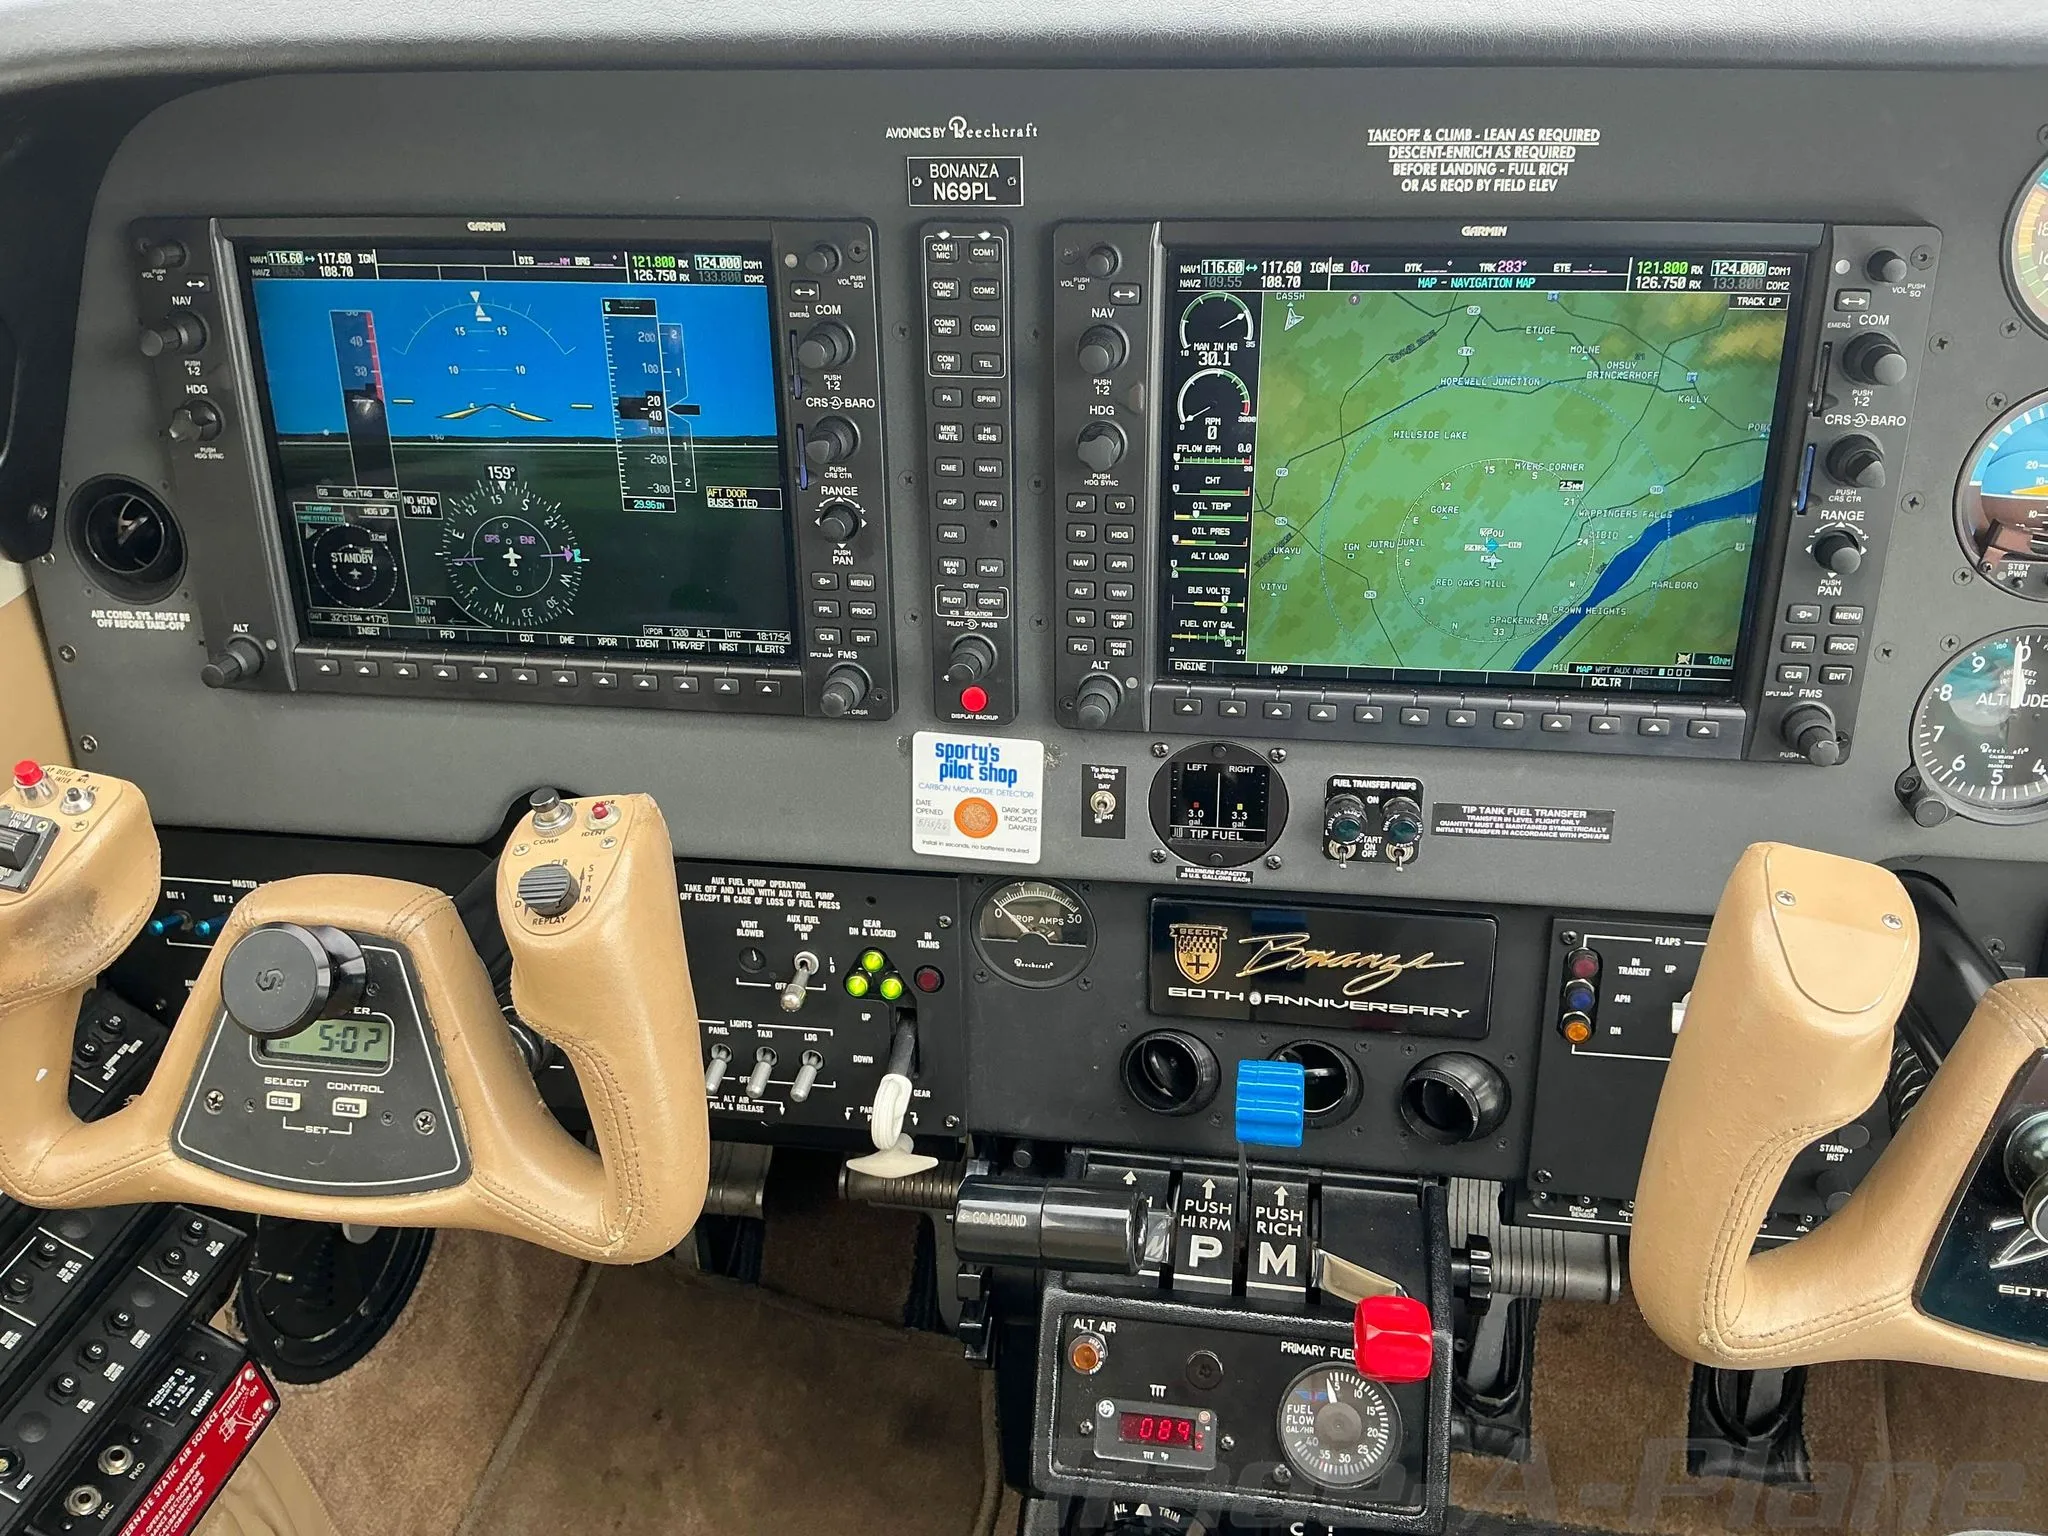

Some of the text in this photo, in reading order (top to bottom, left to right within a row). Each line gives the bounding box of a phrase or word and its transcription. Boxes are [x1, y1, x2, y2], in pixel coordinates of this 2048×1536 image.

[885, 116, 1038, 139] AVIONICS BY Beechcraft
[1368, 128, 1600, 142] TAKEOFF & CLIMB LEAN AS REQUIRED
[1389, 146, 1576, 159] DESCENT-ENRICH AS REQUIRED
[929, 163, 999, 178] BONANZA
[1393, 163, 1568, 176] BEFORE LANDING FULL RICH
[1402, 179, 1558, 192] OR AS REQD BY FIELD ELEV
[933, 182, 997, 201] N69PL
[467, 221, 506, 231] GARMIN
[1461, 226, 1507, 237] GARMIN
[269, 253, 351, 264] 116.60 117.60
[632, 255, 741, 269] 121.800 124.000
[319, 266, 353, 277] 108.70
[1203, 261, 1328, 274] 116.60 117.60 IGN
[1637, 262, 1765, 276] 121.800 124.000
[633, 269, 676, 281] 126.750
[1261, 276, 1301, 288] 108.70
[1418, 277, 1535, 288] MAP NAVIGATION MAP
[1635, 277, 1686, 290] 126.750
[172, 296, 192, 306] NAV
[1737, 296, 1781, 307] TRACK UP
[815, 304, 841, 315] COM
[1091, 308, 1115, 319] NAV
[1859, 314, 1889, 326] COM
[1198, 352, 1231, 366] 30.1
[1440, 377, 1540, 386] HOPEWELL JUNCTION
[186, 385, 208, 395] HDG
[1089, 405, 1115, 416] HDG
[1393, 431, 1467, 440] HILLSIDE LAKE
[821, 486, 858, 496] RANGE
[1192, 502, 1231, 511] OIL TEMP
[1820, 510, 1865, 521] RANGE
[1191, 527, 1230, 536] OIL PRES
[330, 552, 373, 564] STANDBY
[1191, 553, 1229, 561] ALT LOAD
[1187, 586, 1231, 595] BUS VOLTS
[1651, 580, 1699, 590] MARLBORO
[1817, 586, 1842, 597] PAN
[1835, 611, 1860, 620] MENU
[1180, 620, 1235, 630] FUEL QTY GAL
[755, 644, 785, 655] ALERTS
[1830, 642, 1855, 651] PROC
[1174, 662, 1207, 672] ENGINE
[1591, 677, 1622, 688] DCLTR
[1798, 688, 1823, 698] FMS
[951, 713, 974, 721] DISPLAY
[1933, 725, 1945, 743] 7
[935, 742, 1000, 765] sporty's
[1187, 764, 1254, 773] LEFT RIGHT
[1952, 755, 1965, 772] 6
[939, 760, 1018, 787] pilot shop
[918, 782, 1034, 798] CARBON MONOXIDE DETECTOR
[1333, 779, 1416, 790] FUEL TRANSFER PUMPS
[916, 798, 932, 807] DATE
[916, 807, 944, 816] OPENED
[1001, 806, 1038, 815] DARK SPOT
[1188, 809, 1248, 820] 3.0 3.3
[1462, 806, 1587, 819] TIP TANK FUEL TRANSFER
[1003, 815, 1037, 824] INDICATES
[1008, 824, 1037, 832] DANGER
[1190, 829, 1244, 841] TIP FUEL
[711, 877, 806, 890] AUX FUEL PUMP OPERATION
[684, 884, 834, 900] TAKE OFF AND LAND WITH AUX FUEL PUMP
[532, 916, 567, 926] REPLAY
[1039, 913, 1082, 926] AMPS 30
[736, 928, 764, 938] BLOWER
[870, 928, 897, 938] LOCKED
[916, 940, 940, 950] TRANS
[1655, 937, 1681, 947] FLAPS
[1618, 966, 1651, 976] TRANSIT
[1168, 987, 1470, 1019] 60TH ANNIVERSARY
[729, 1020, 753, 1029] LIGHTS
[708, 1026, 729, 1036] PANEL
[853, 1055, 874, 1064] DOWN
[264, 1077, 309, 1087] SELECT
[326, 1082, 385, 1094] CONTROL
[913, 1089, 931, 1098] GEAR
[305, 1125, 329, 1135] SET
[1185, 1199, 1232, 1216] PUSH
[987, 1212, 1026, 1227] AROUND
[1256, 1206, 1303, 1222] PUSH
[1181, 1215, 1232, 1232] HI RPM
[1256, 1221, 1302, 1237] RICH
[1189, 1235, 1223, 1268] P
[1258, 1241, 1297, 1278] M
[1073, 1319, 1117, 1334] ALT AIR
[1280, 1341, 1356, 1360] PRIMARY FUEL
[190, 1389, 214, 1417] FLIGHT
[1286, 1404, 1314, 1415] FUEL
[1285, 1414, 1314, 1425] FLOW
[191, 1411, 219, 1447] SOURCE
